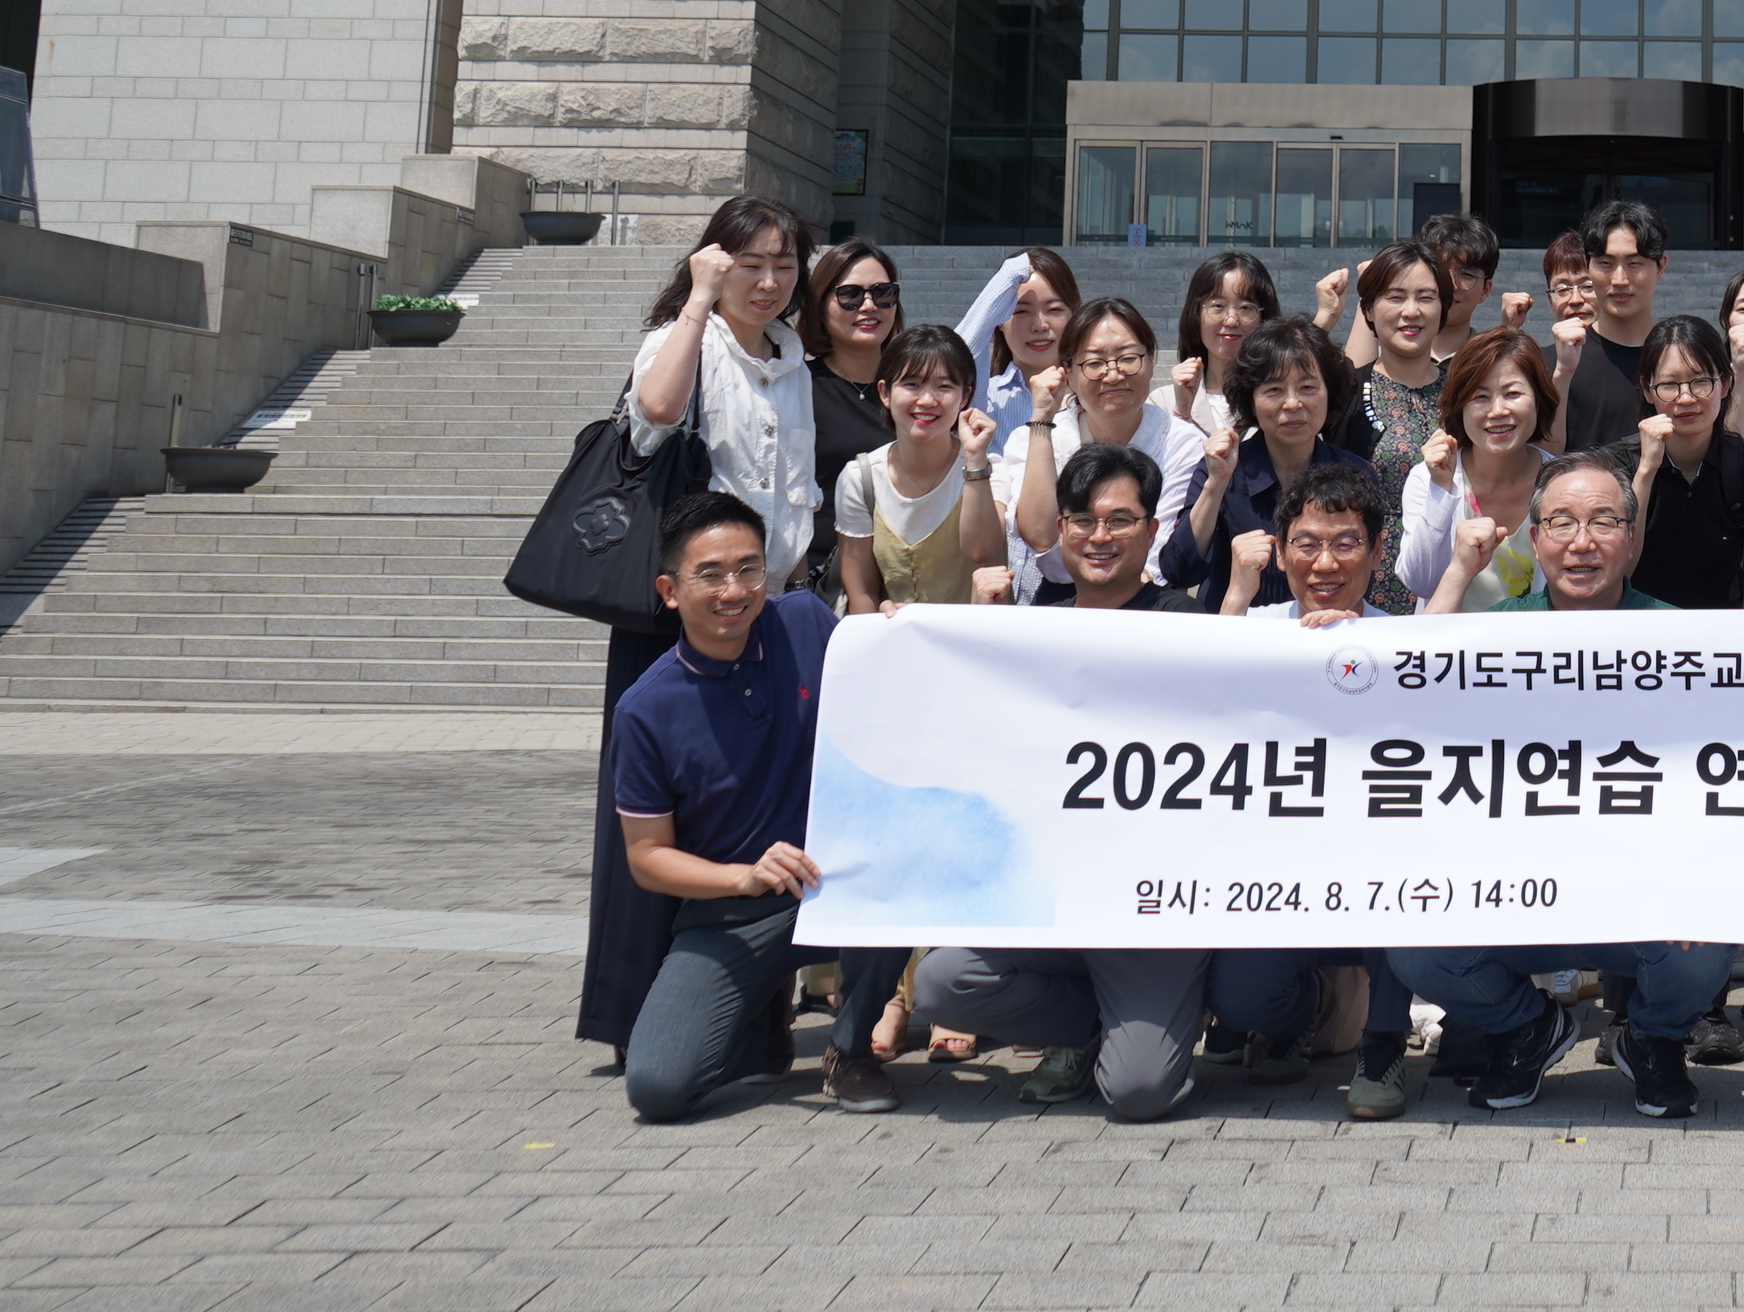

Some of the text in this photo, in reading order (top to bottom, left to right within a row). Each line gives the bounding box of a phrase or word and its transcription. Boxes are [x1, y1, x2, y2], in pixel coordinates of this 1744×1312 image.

[1062, 737, 1327, 817] 2024년
[1361, 738, 1664, 818] 을지연습
[1135, 879, 1211, 915] 일시:
[1226, 882, 1310, 912] 2024.
[1325, 882, 1350, 912] 8.
[1472, 878, 1558, 909] 14:00
